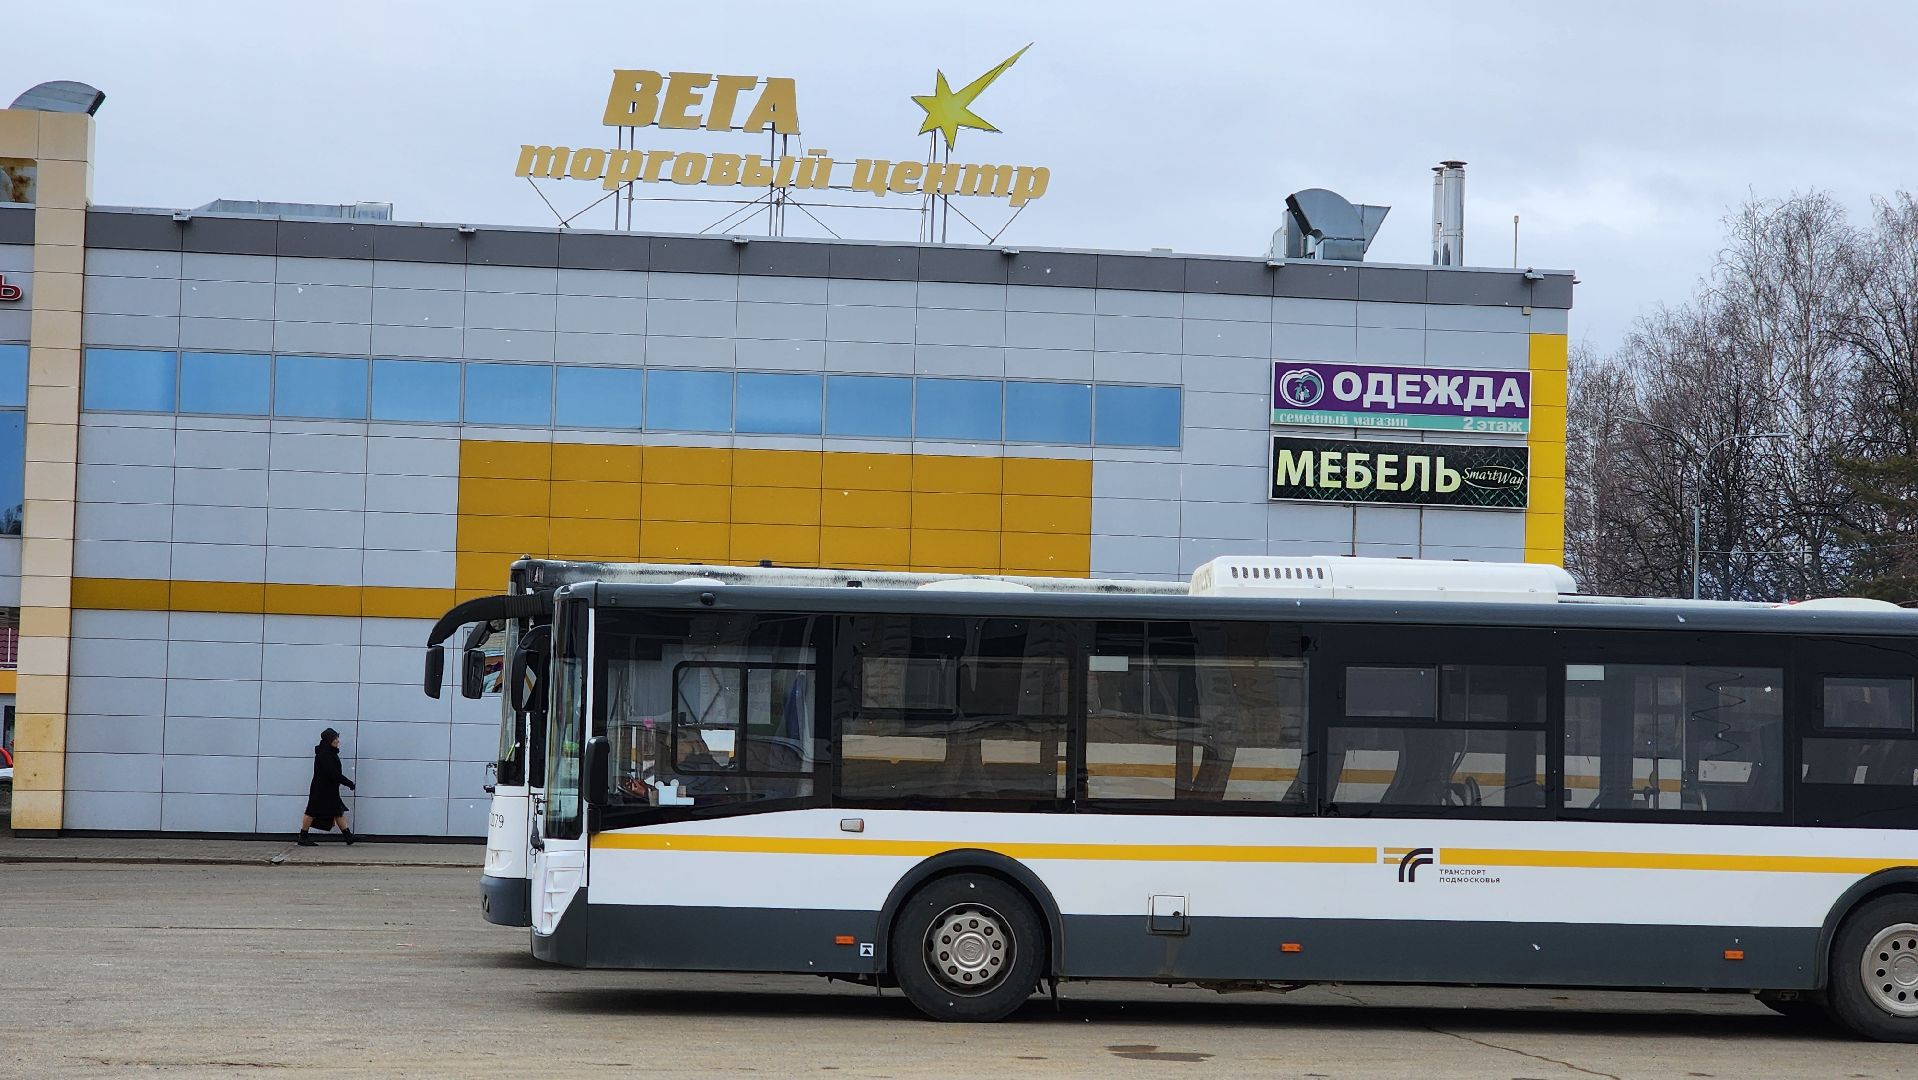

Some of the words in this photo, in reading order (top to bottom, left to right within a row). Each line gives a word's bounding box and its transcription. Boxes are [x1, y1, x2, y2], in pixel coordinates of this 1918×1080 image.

[602, 69, 801, 135] ВЕГА
[515, 144, 833, 190] торговый
[852, 158, 1051, 207] центр
[1332, 371, 1526, 413] ОДЕЖДА
[1279, 412, 1349, 425] семейный
[1353, 417, 1409, 428] магазин
[1463, 416, 1474, 430] 2
[1476, 420, 1523, 433] этаж
[1276, 449, 1461, 493] МЕБЕЛЬ
[1462, 467, 1525, 490] SmartWay
